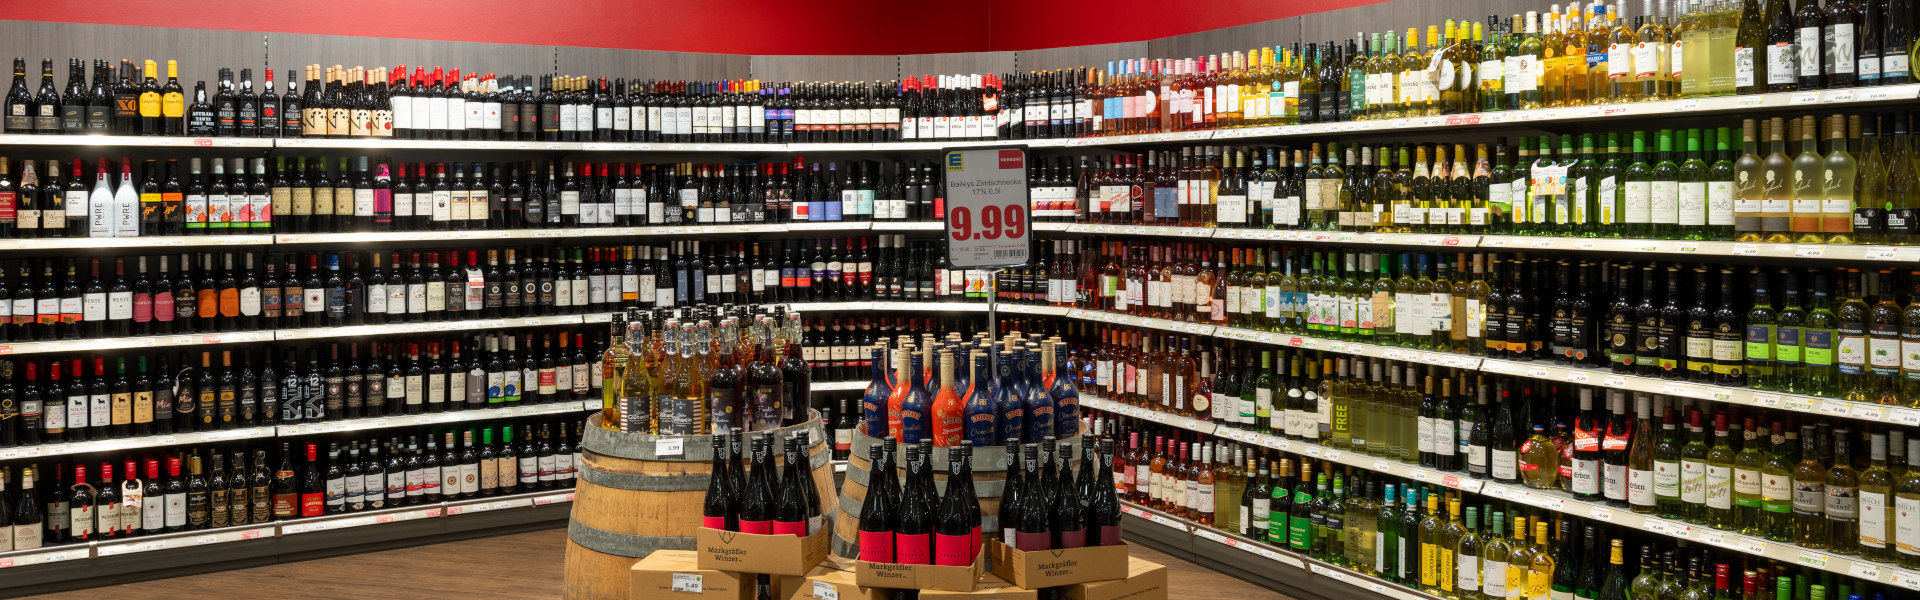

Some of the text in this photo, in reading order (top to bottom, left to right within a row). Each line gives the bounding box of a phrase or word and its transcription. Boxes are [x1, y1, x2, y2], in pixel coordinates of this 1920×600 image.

[117, 100, 136, 111] XO
[951, 179, 1021, 189] Baileys Zimtschnecke
[951, 204, 1025, 241] 9.99
[288, 378, 297, 387] 12
[310, 378, 319, 387] 12
[971, 414, 995, 423] BAILEYS
[1336, 405, 1347, 430] FREE
[1573, 472, 1591, 480] Erben
[708, 547, 747, 555] Markgräfler
[714, 554, 739, 562] Winzer
[868, 562, 912, 571] Markgräfler
[1038, 560, 1077, 570] Markgräfler
[1045, 569, 1068, 577] Winzer
